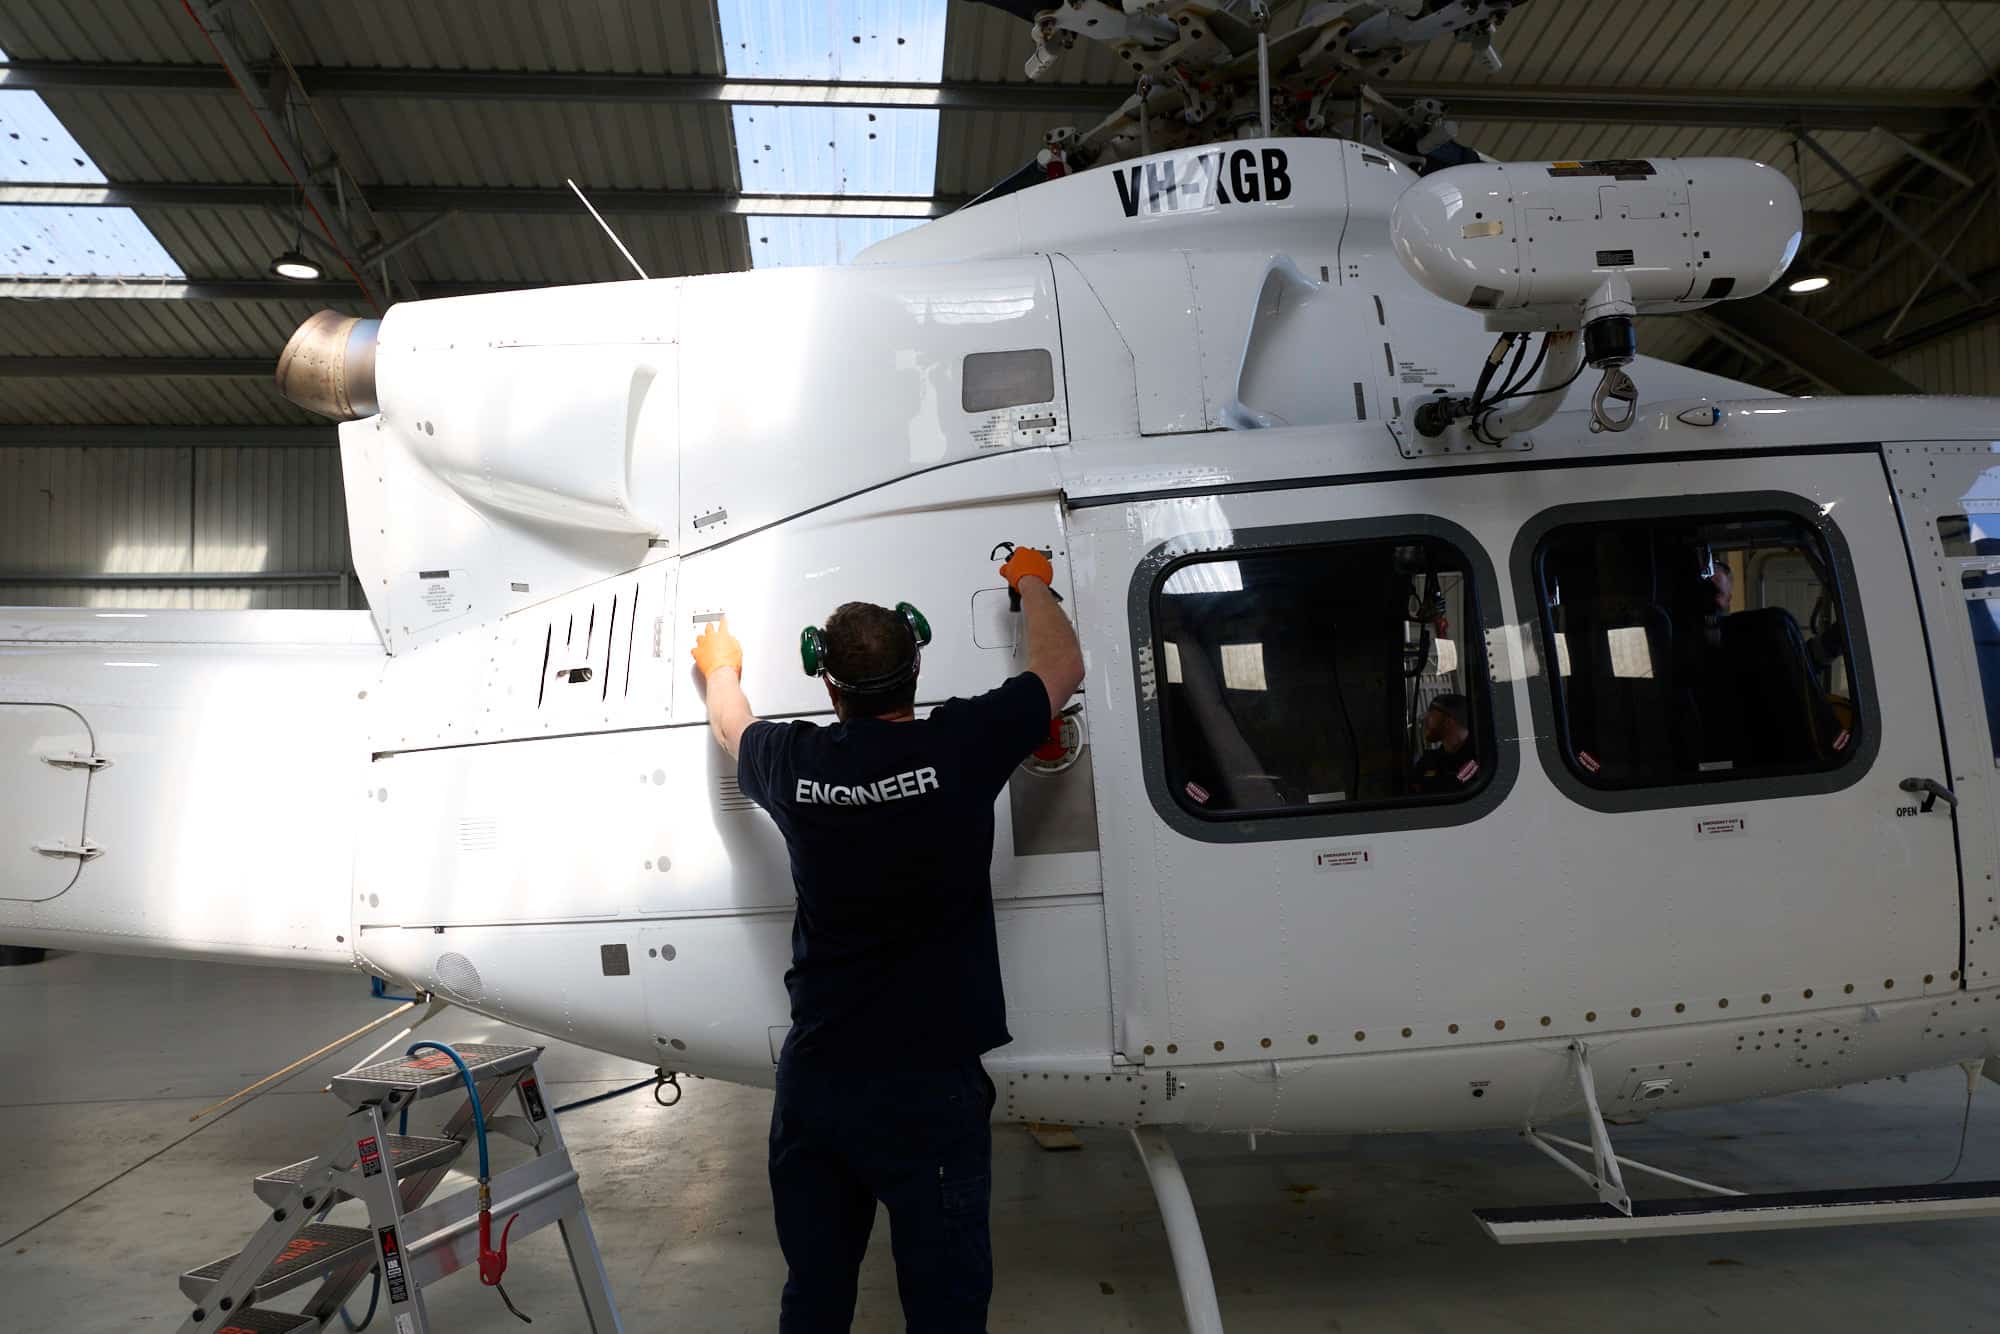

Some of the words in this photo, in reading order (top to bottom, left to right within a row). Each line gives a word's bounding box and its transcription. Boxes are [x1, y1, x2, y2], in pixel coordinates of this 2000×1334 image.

[1112, 148, 1292, 218] VH-XGB
[795, 766, 940, 806] ENGINEER
[1896, 806, 1918, 817] OPEN
